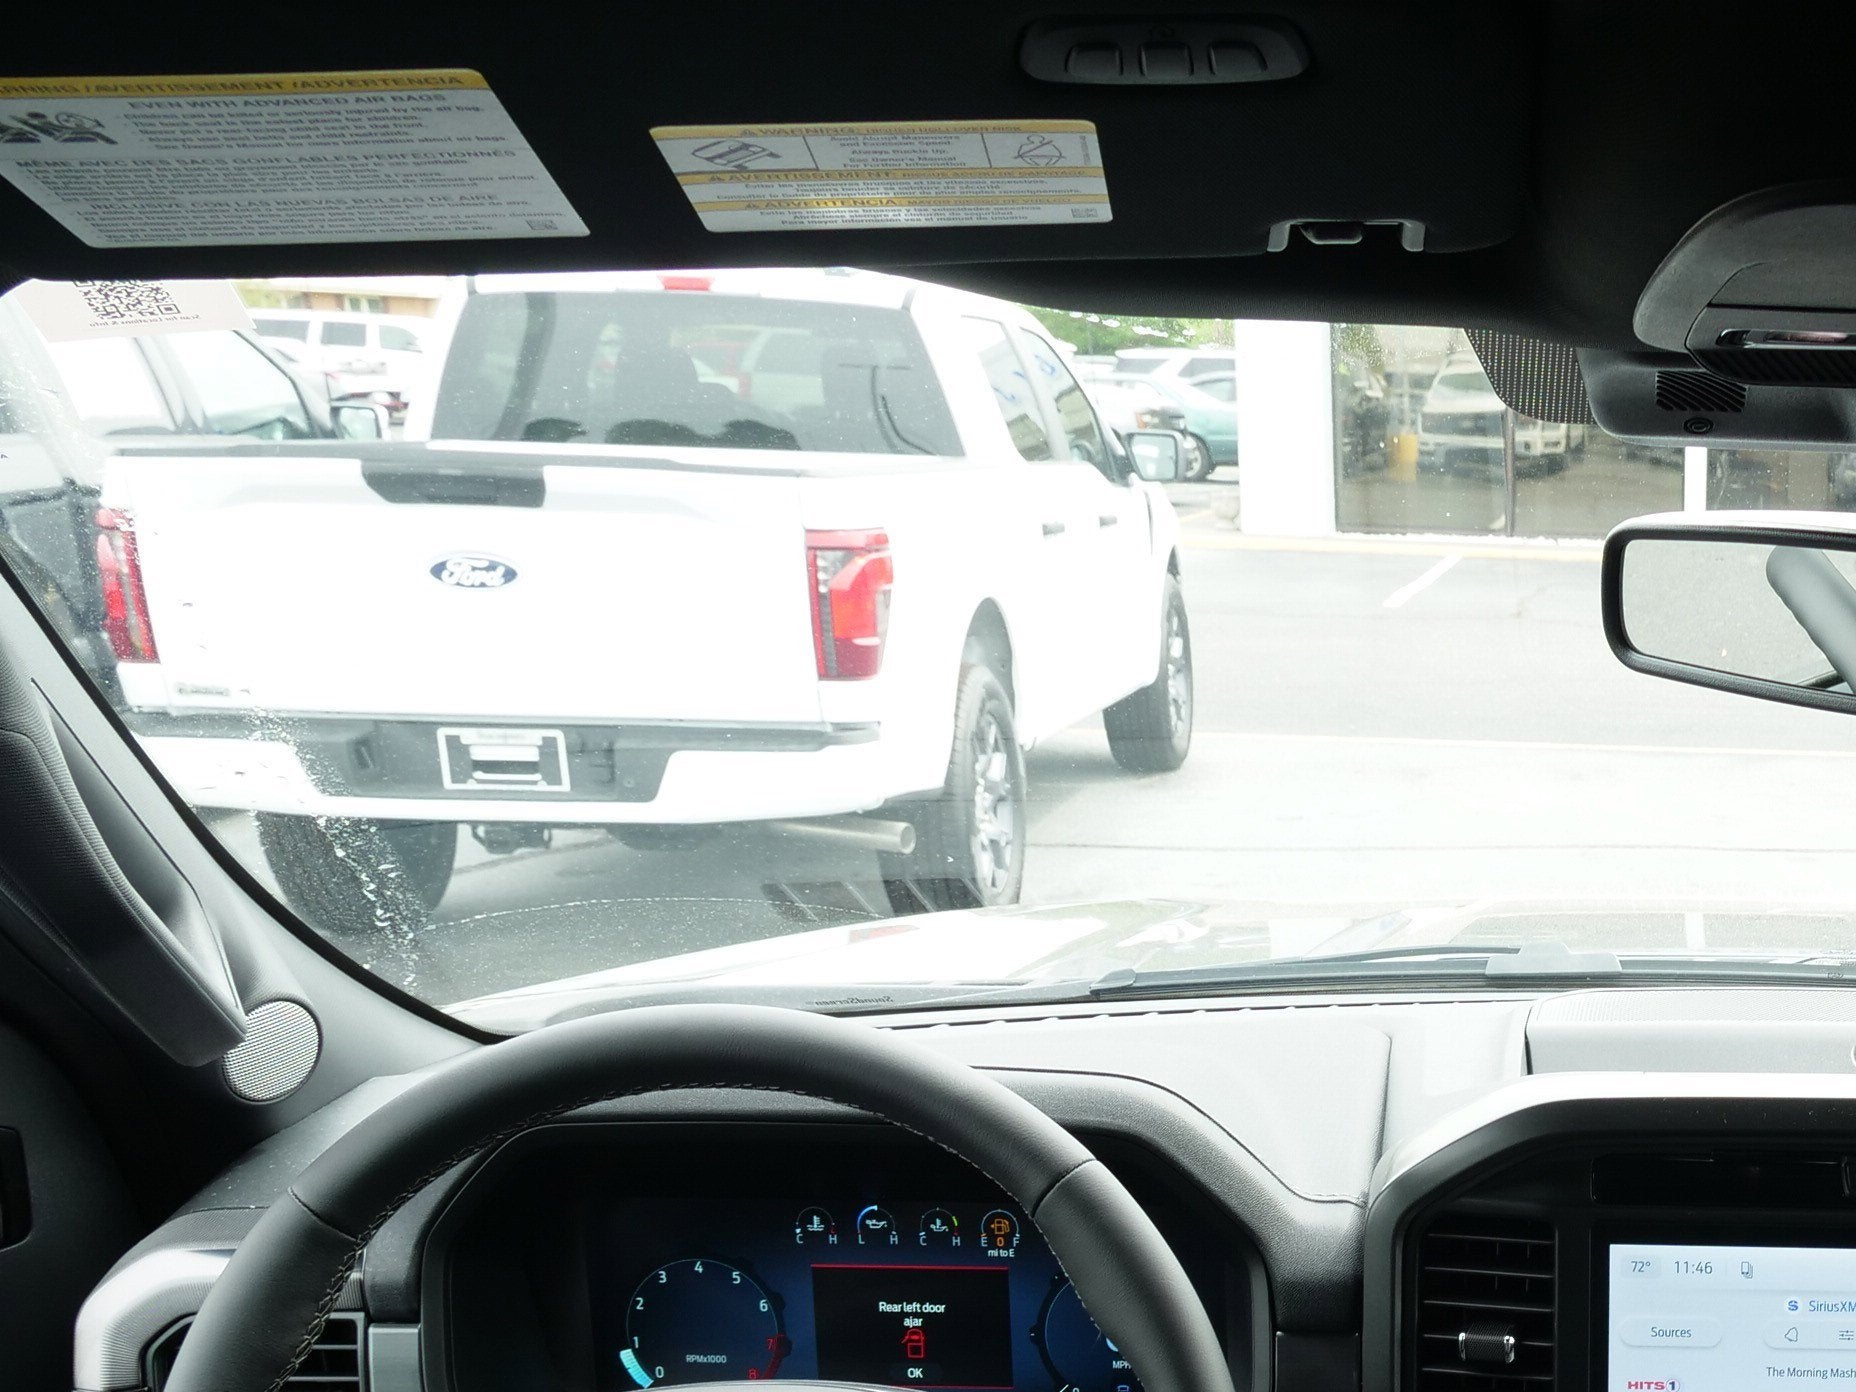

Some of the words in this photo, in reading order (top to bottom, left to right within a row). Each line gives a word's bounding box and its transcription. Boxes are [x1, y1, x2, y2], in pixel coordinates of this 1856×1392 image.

[441, 556, 506, 586] Ford
[796, 1234, 804, 1245] C
[829, 1234, 837, 1245] H
[858, 1234, 865, 1245] L
[890, 1234, 898, 1245] H
[919, 1235, 927, 1246] C
[953, 1236, 961, 1247] H
[981, 1237, 987, 1247] E
[1013, 1237, 1020, 1247] F
[988, 1249, 998, 1258] mi
[999, 1249, 1008, 1258] to
[1009, 1249, 1015, 1258] E
[694, 1261, 703, 1273] 4
[1630, 1261, 1651, 1273] 72°
[1674, 1261, 1713, 1274] 11:46
[658, 1271, 667, 1283] 3
[732, 1272, 741, 1284] 5
[636, 1298, 644, 1310] 2
[759, 1300, 768, 1312] 6
[879, 1302, 902, 1313] Rear
[902, 1302, 921, 1313] left
[922, 1302, 946, 1313] door
[903, 1316, 923, 1328] ajar
[1651, 1327, 1692, 1338] Sources
[633, 1336, 639, 1348] 1
[767, 1338, 773, 1350] 7
[686, 1354, 727, 1364] RPMx1000
[1112, 1360, 1132, 1369] MPH
[655, 1366, 664, 1378] 0
[907, 1368, 923, 1379] OK
[1766, 1367, 1785, 1378] The
[1787, 1367, 1828, 1380] Morning
[1830, 1368, 1856, 1379] Mash
